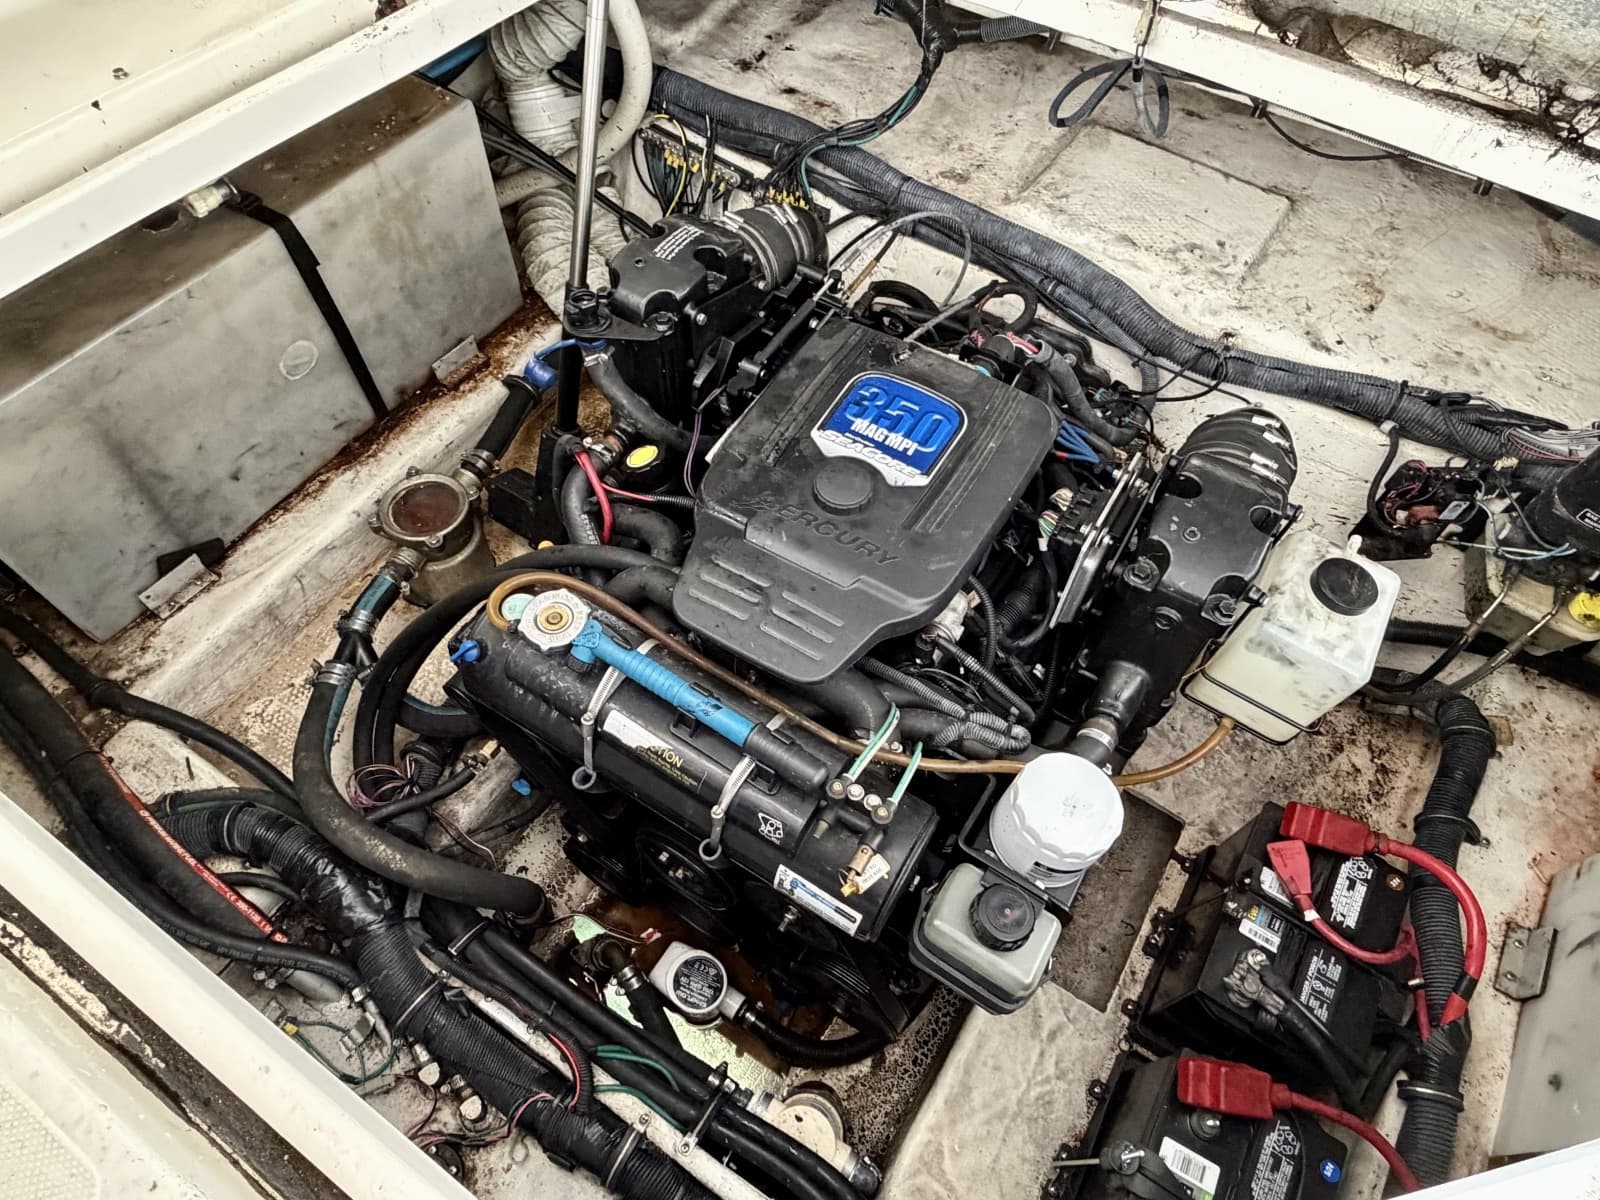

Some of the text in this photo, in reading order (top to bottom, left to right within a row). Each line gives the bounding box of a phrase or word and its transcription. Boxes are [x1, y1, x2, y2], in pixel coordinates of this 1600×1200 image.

[845, 385, 953, 453] 350
[850, 417, 889, 443] MAG
[884, 432, 919, 456] MPI
[819, 430, 922, 478] SEACORE
[748, 490, 902, 566] ERCURY
